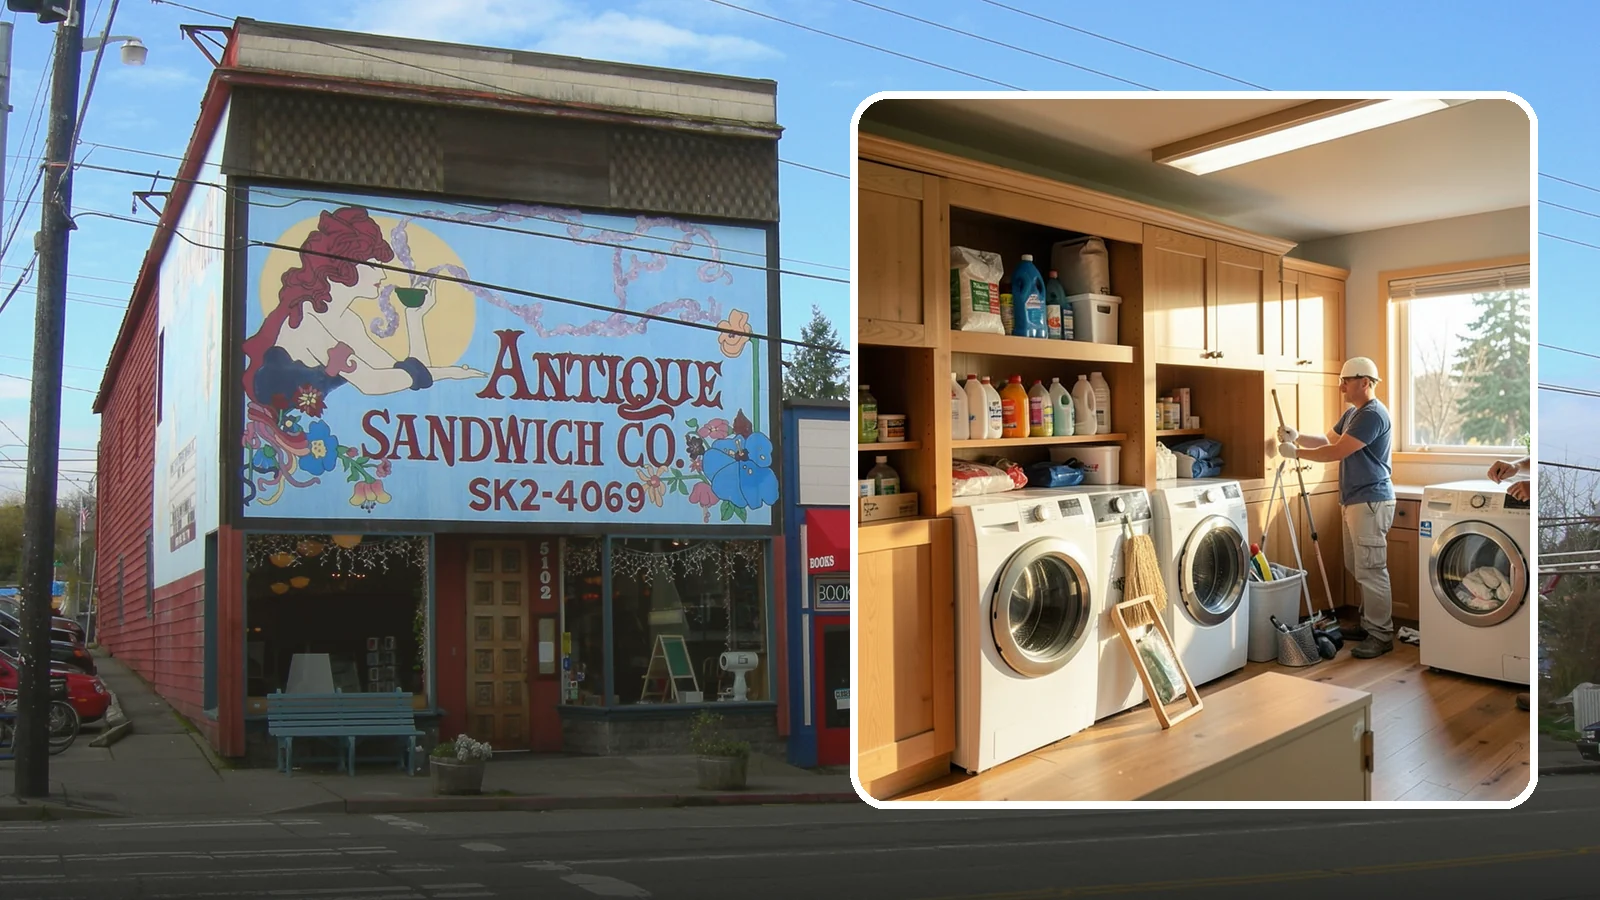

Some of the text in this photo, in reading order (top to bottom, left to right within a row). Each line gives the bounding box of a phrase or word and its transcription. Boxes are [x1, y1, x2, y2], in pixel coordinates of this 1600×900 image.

[476, 329, 724, 420] ANTIQUE
[361, 408, 685, 469] SANDWICH CO.
[468, 477, 646, 513] SK2-4069
[539, 541, 552, 600] 5102
[809, 555, 835, 569] BOOKS
